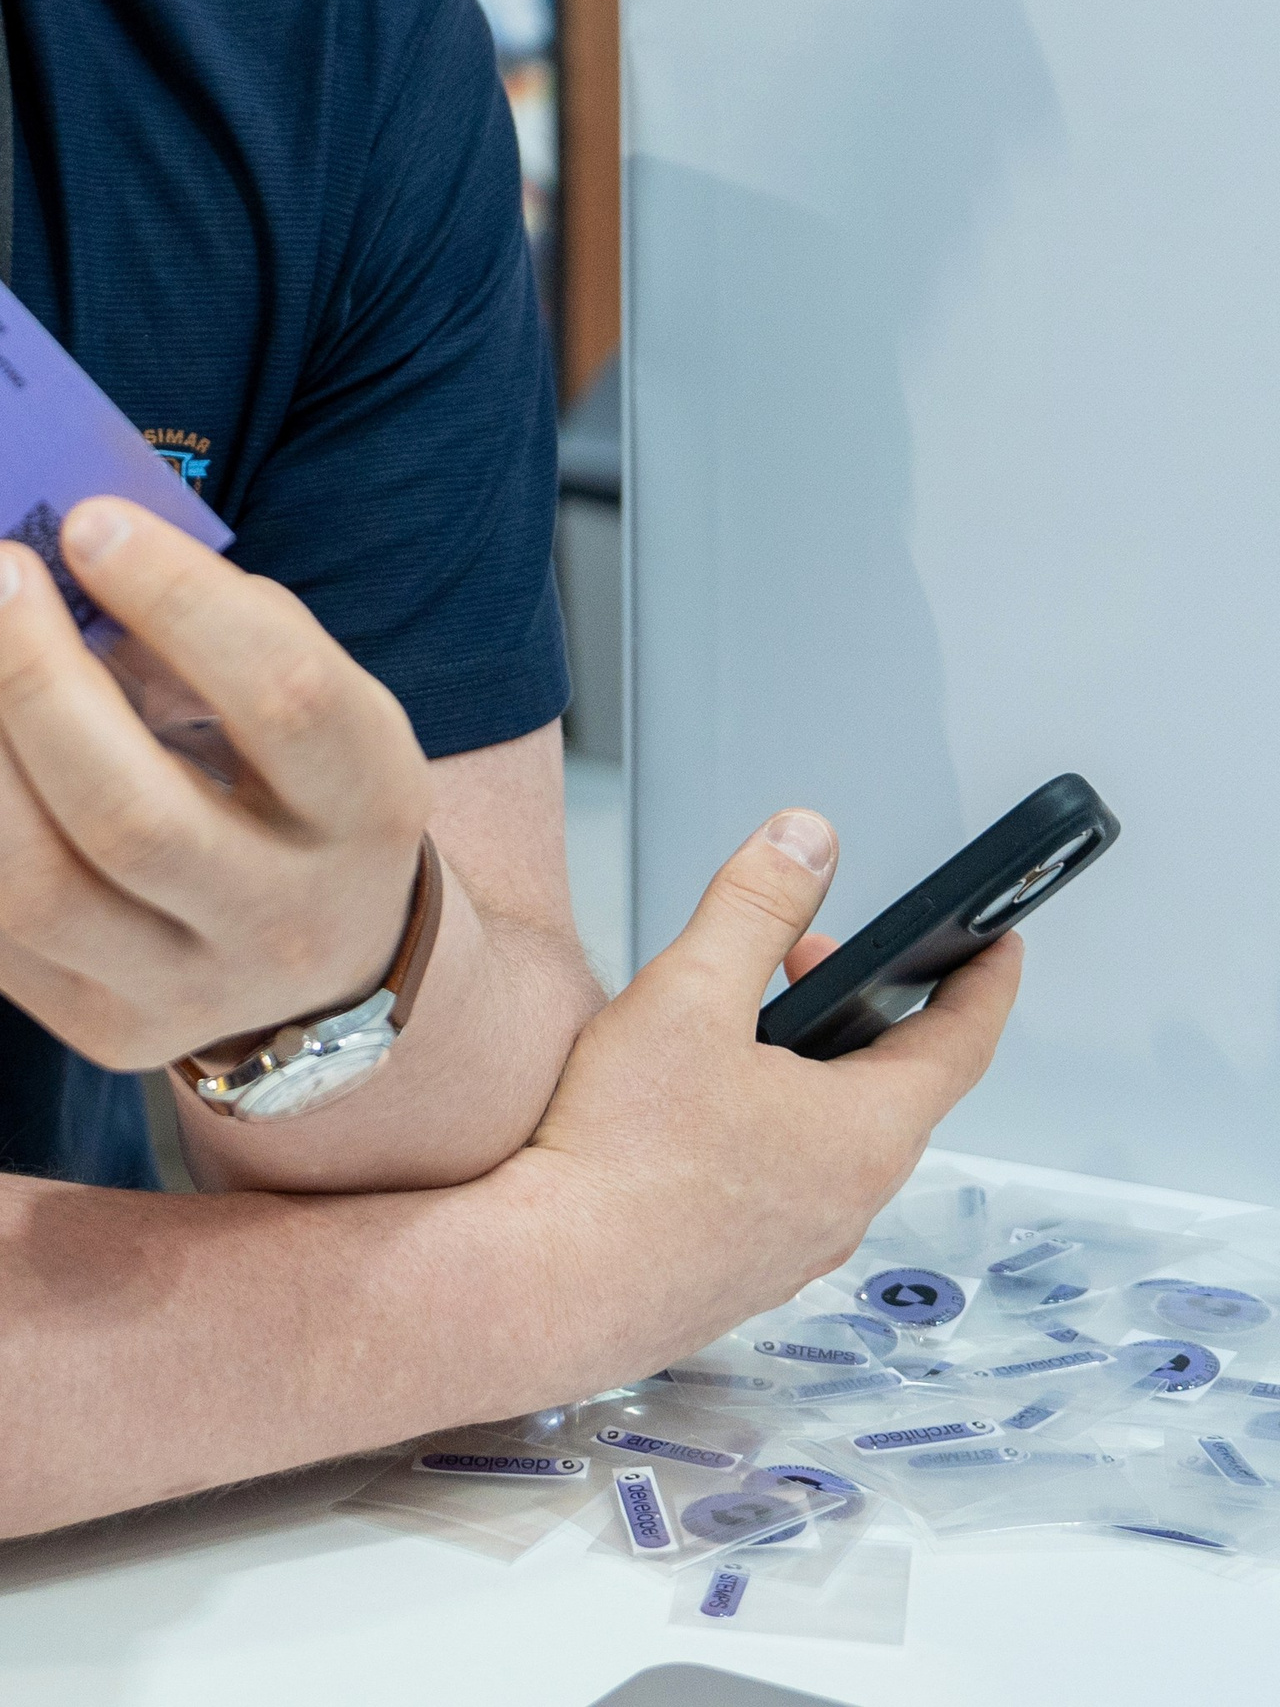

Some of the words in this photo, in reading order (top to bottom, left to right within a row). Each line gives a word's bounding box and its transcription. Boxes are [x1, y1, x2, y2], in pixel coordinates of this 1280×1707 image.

[785, 1343, 856, 1362] STEMPS
[626, 1433, 722, 1463] architect
[867, 1422, 965, 1448] architect
[436, 1453, 551, 1473] developer
[628, 1484, 661, 1540] developer
